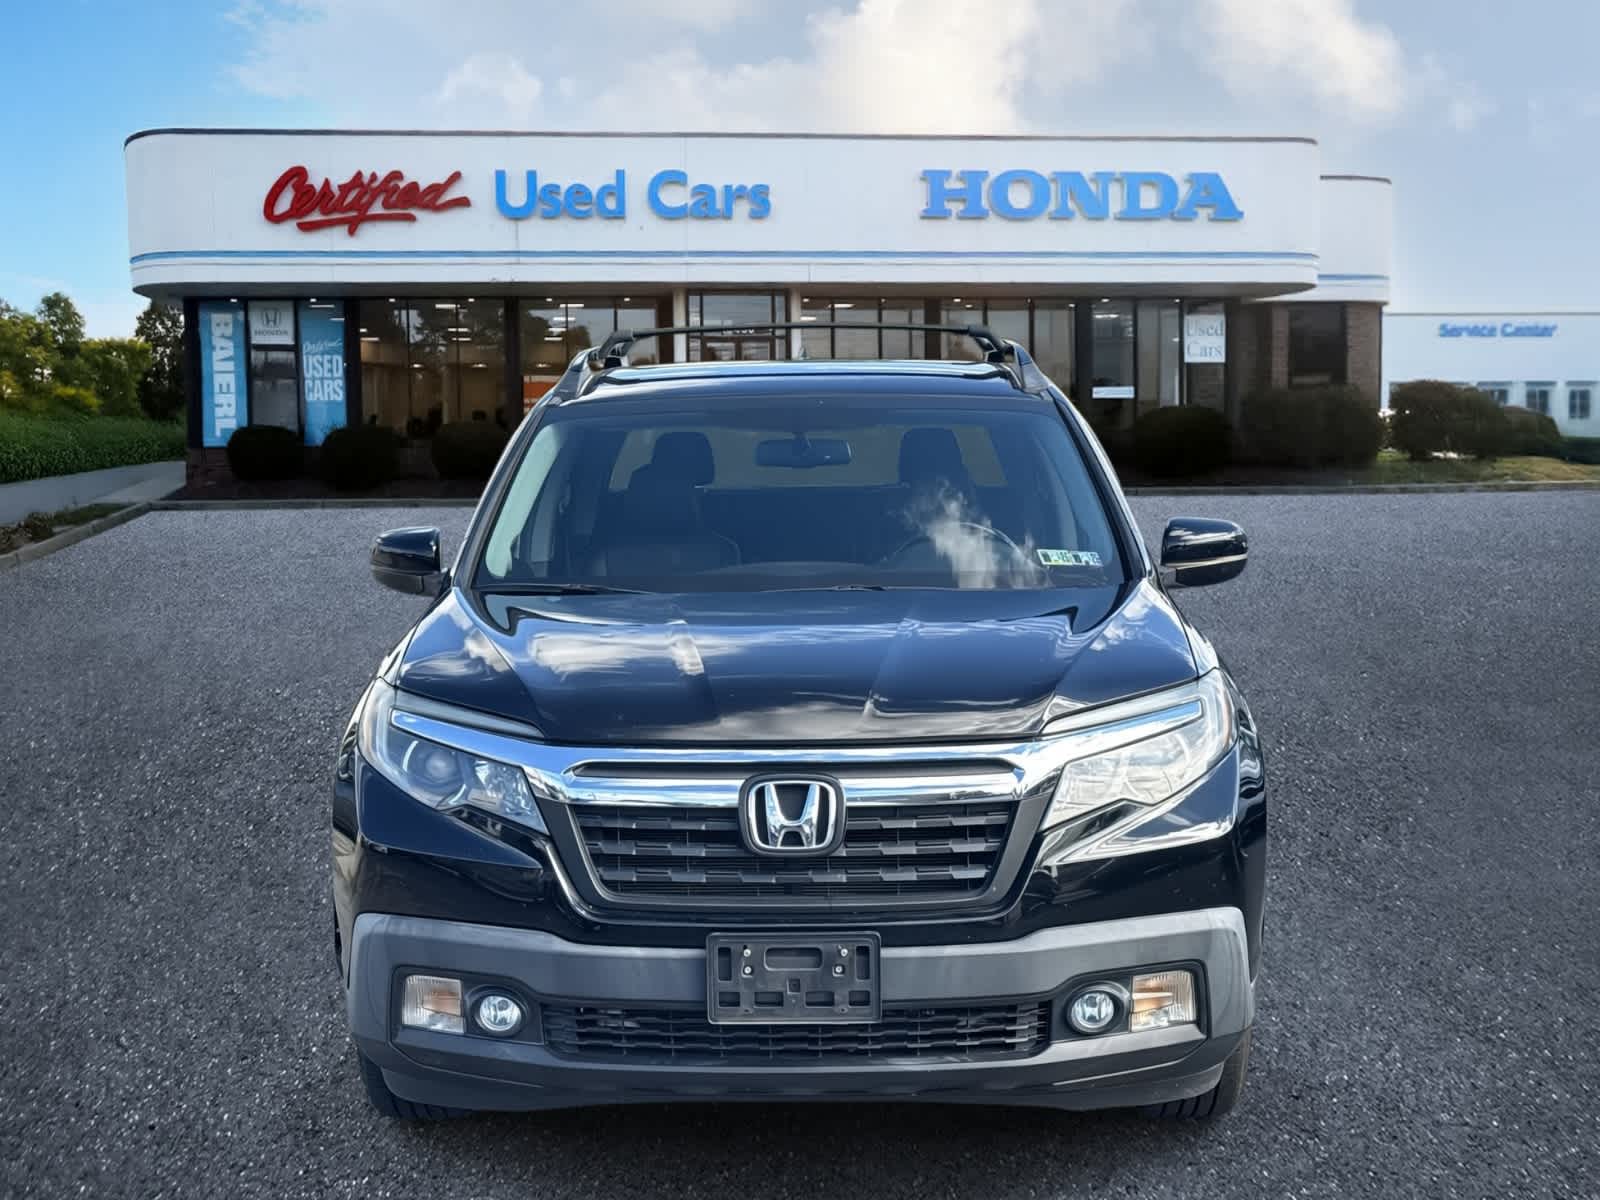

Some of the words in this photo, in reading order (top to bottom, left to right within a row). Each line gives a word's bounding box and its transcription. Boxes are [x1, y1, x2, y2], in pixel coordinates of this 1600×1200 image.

[262, 165, 471, 236] Certified
[494, 169, 627, 220] Used
[647, 169, 771, 220] Cars
[920, 169, 1244, 221] HONDA
[254, 328, 289, 337] HONDA
[1186, 317, 1224, 337] Used
[1438, 322, 1497, 337] Service
[1501, 322, 1557, 337] Center
[1186, 342, 1224, 358] Cars
[211, 312, 237, 437] BAIERL
[303, 354, 342, 377] USED
[304, 379, 344, 401] CARS
